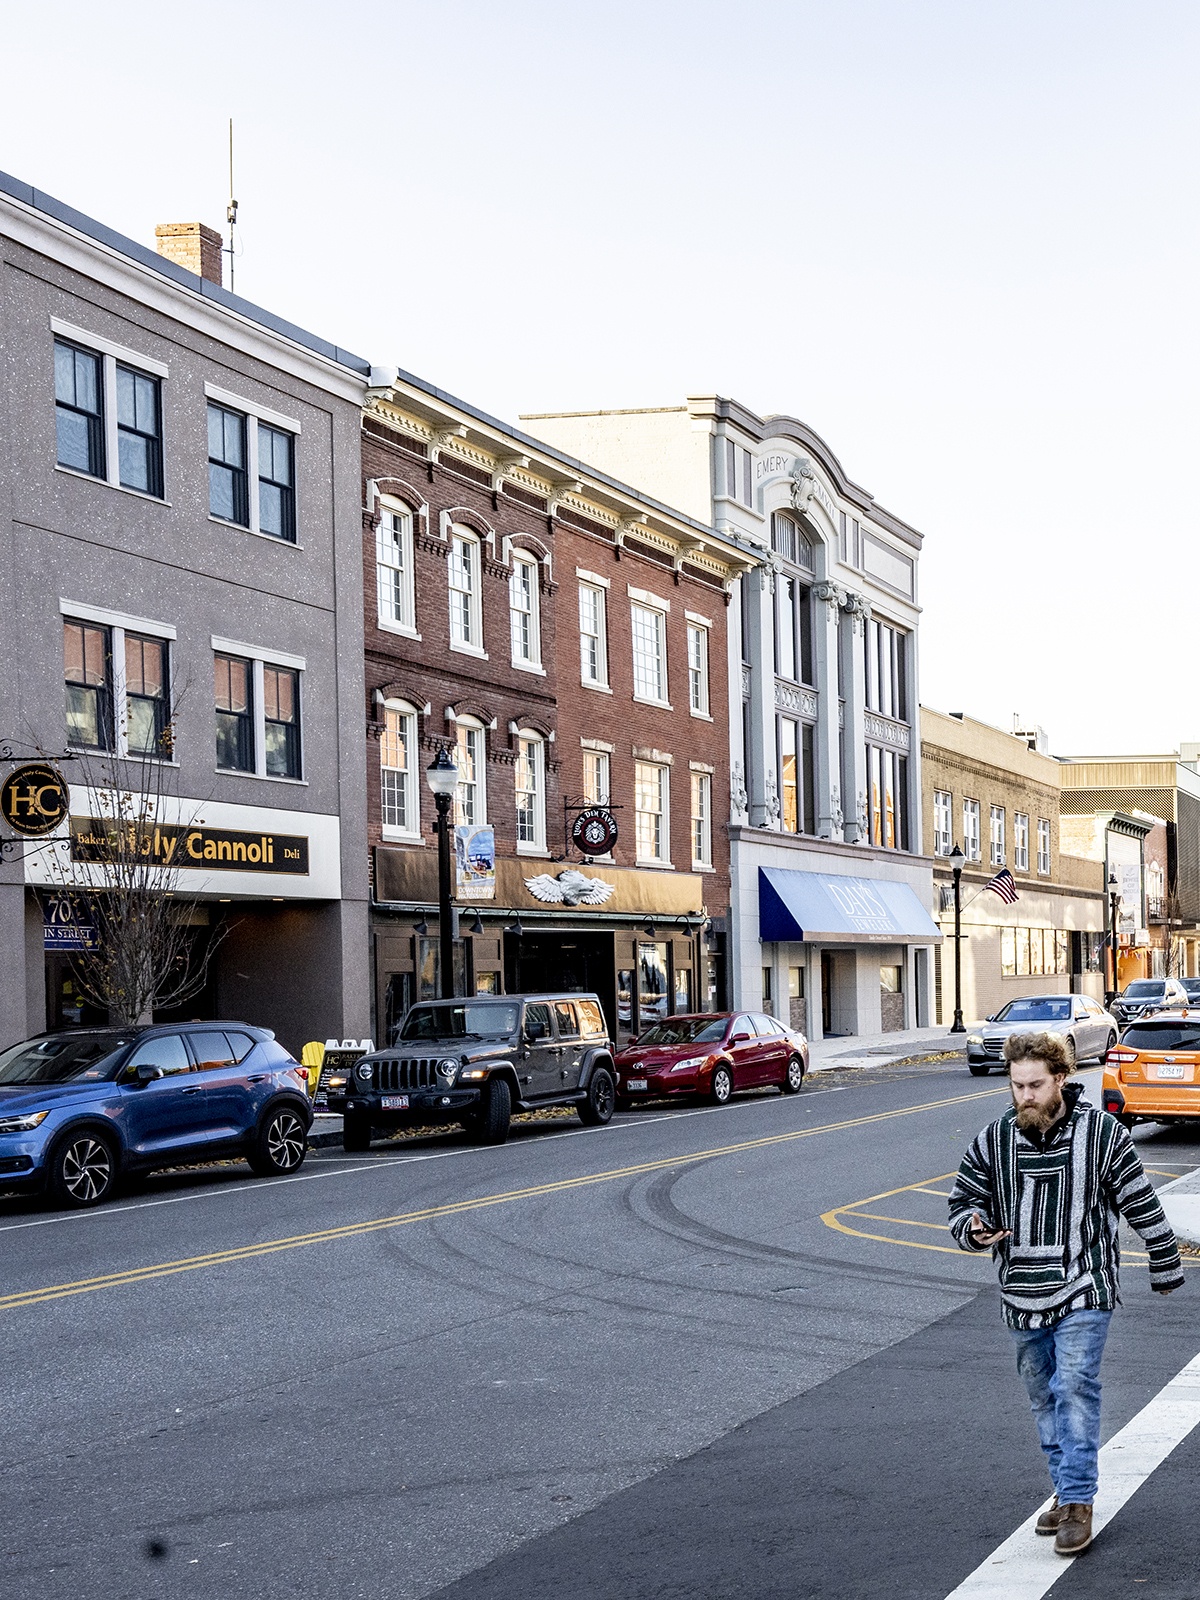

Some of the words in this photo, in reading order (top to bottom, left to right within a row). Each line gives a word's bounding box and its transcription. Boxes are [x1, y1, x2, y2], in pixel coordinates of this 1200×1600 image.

[756, 455, 789, 479] EMERY
[9, 785, 61, 816] HC
[77, 832, 112, 846] Bakery
[186, 832, 274, 864] Cannoli
[284, 848, 300, 859] Deli
[48, 900, 71, 923] 70
[852, 919, 896, 931] JEWELERS
